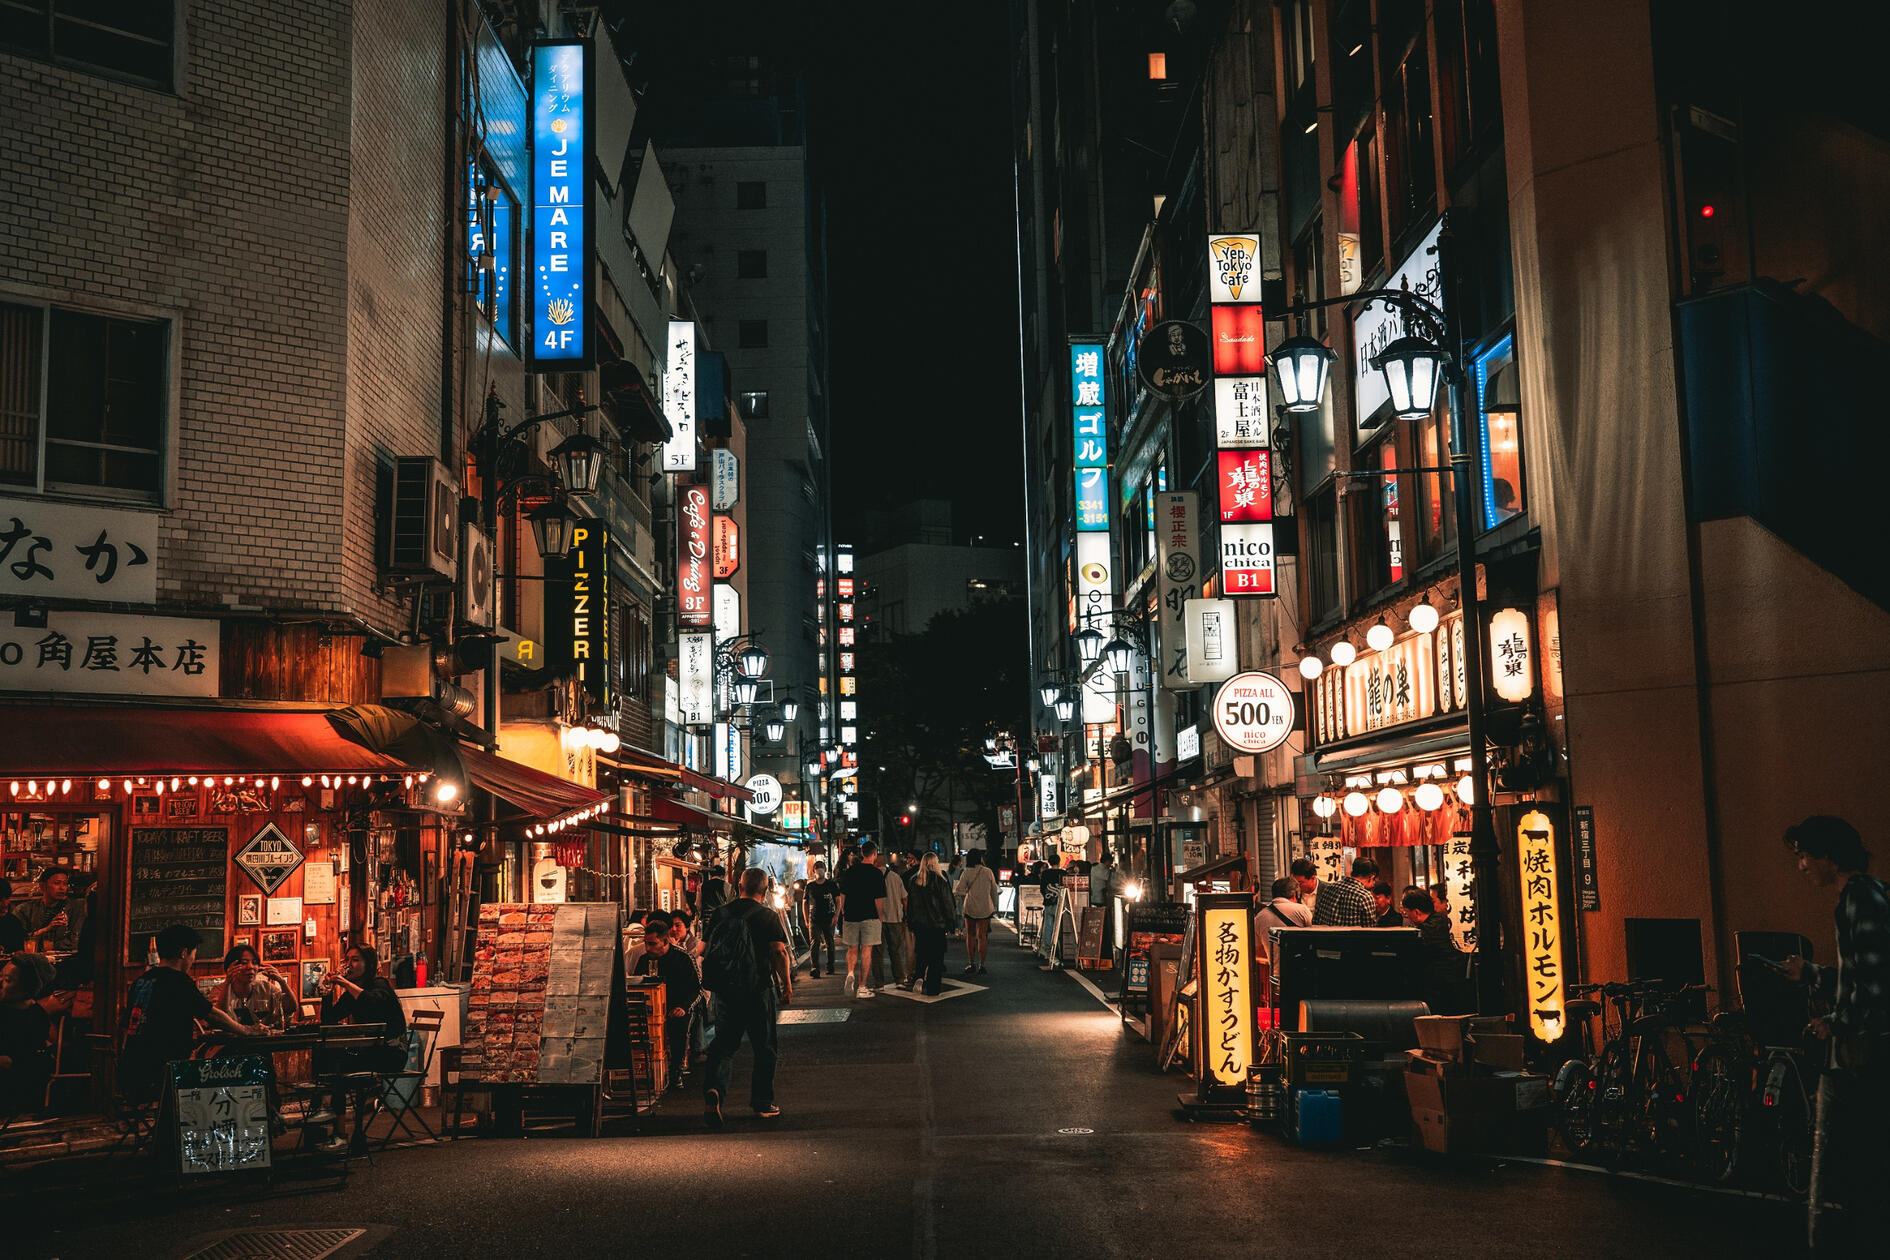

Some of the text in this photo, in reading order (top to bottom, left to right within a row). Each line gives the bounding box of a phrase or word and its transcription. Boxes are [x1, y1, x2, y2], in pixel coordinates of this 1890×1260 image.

[549, 138, 569, 273] JEMARE
[1221, 247, 1249, 262] Yep.
[1216, 259, 1252, 275] Tokyo
[1220, 270, 1249, 287] Café
[544, 330, 574, 350] 4F
[1232, 382, 1251, 438] 富士屋
[1250, 381, 1262, 437] 日本酒バル
[1075, 351, 1103, 489] 増蔵ゴルフ
[671, 454, 690, 466] 5F
[1258, 453, 1269, 499] 焼肉ホルモン
[1223, 511, 1234, 519] 1F
[1224, 538, 1271, 556] nico
[683, 540, 706, 593] Dining
[719, 566, 729, 574] 3F
[1224, 558, 1271, 568] chica
[1237, 573, 1260, 587] B1
[573, 528, 590, 692] PIZZERI
[685, 596, 705, 610] 3F
[35, 631, 207, 676] 角屋本店
[1498, 632, 1528, 678] 龍の巣
[1234, 688, 1275, 698] PIZZA ALL
[1367, 657, 1411, 716] 龍の巣
[690, 712, 701, 721] B1
[1225, 701, 1284, 726] 500 YEN
[1244, 730, 1266, 739] nico
[752, 779, 769, 787] PIZZA
[260, 840, 282, 852] TOKYO
[1580, 821, 1591, 868] 新宿三丁目
[1584, 873, 1591, 885] 9
[1523, 849, 1559, 1004] 焼肉ホルモン
[1215, 922, 1242, 1074] 名物かすうどん
[199, 1064, 242, 1081] Grolsch
